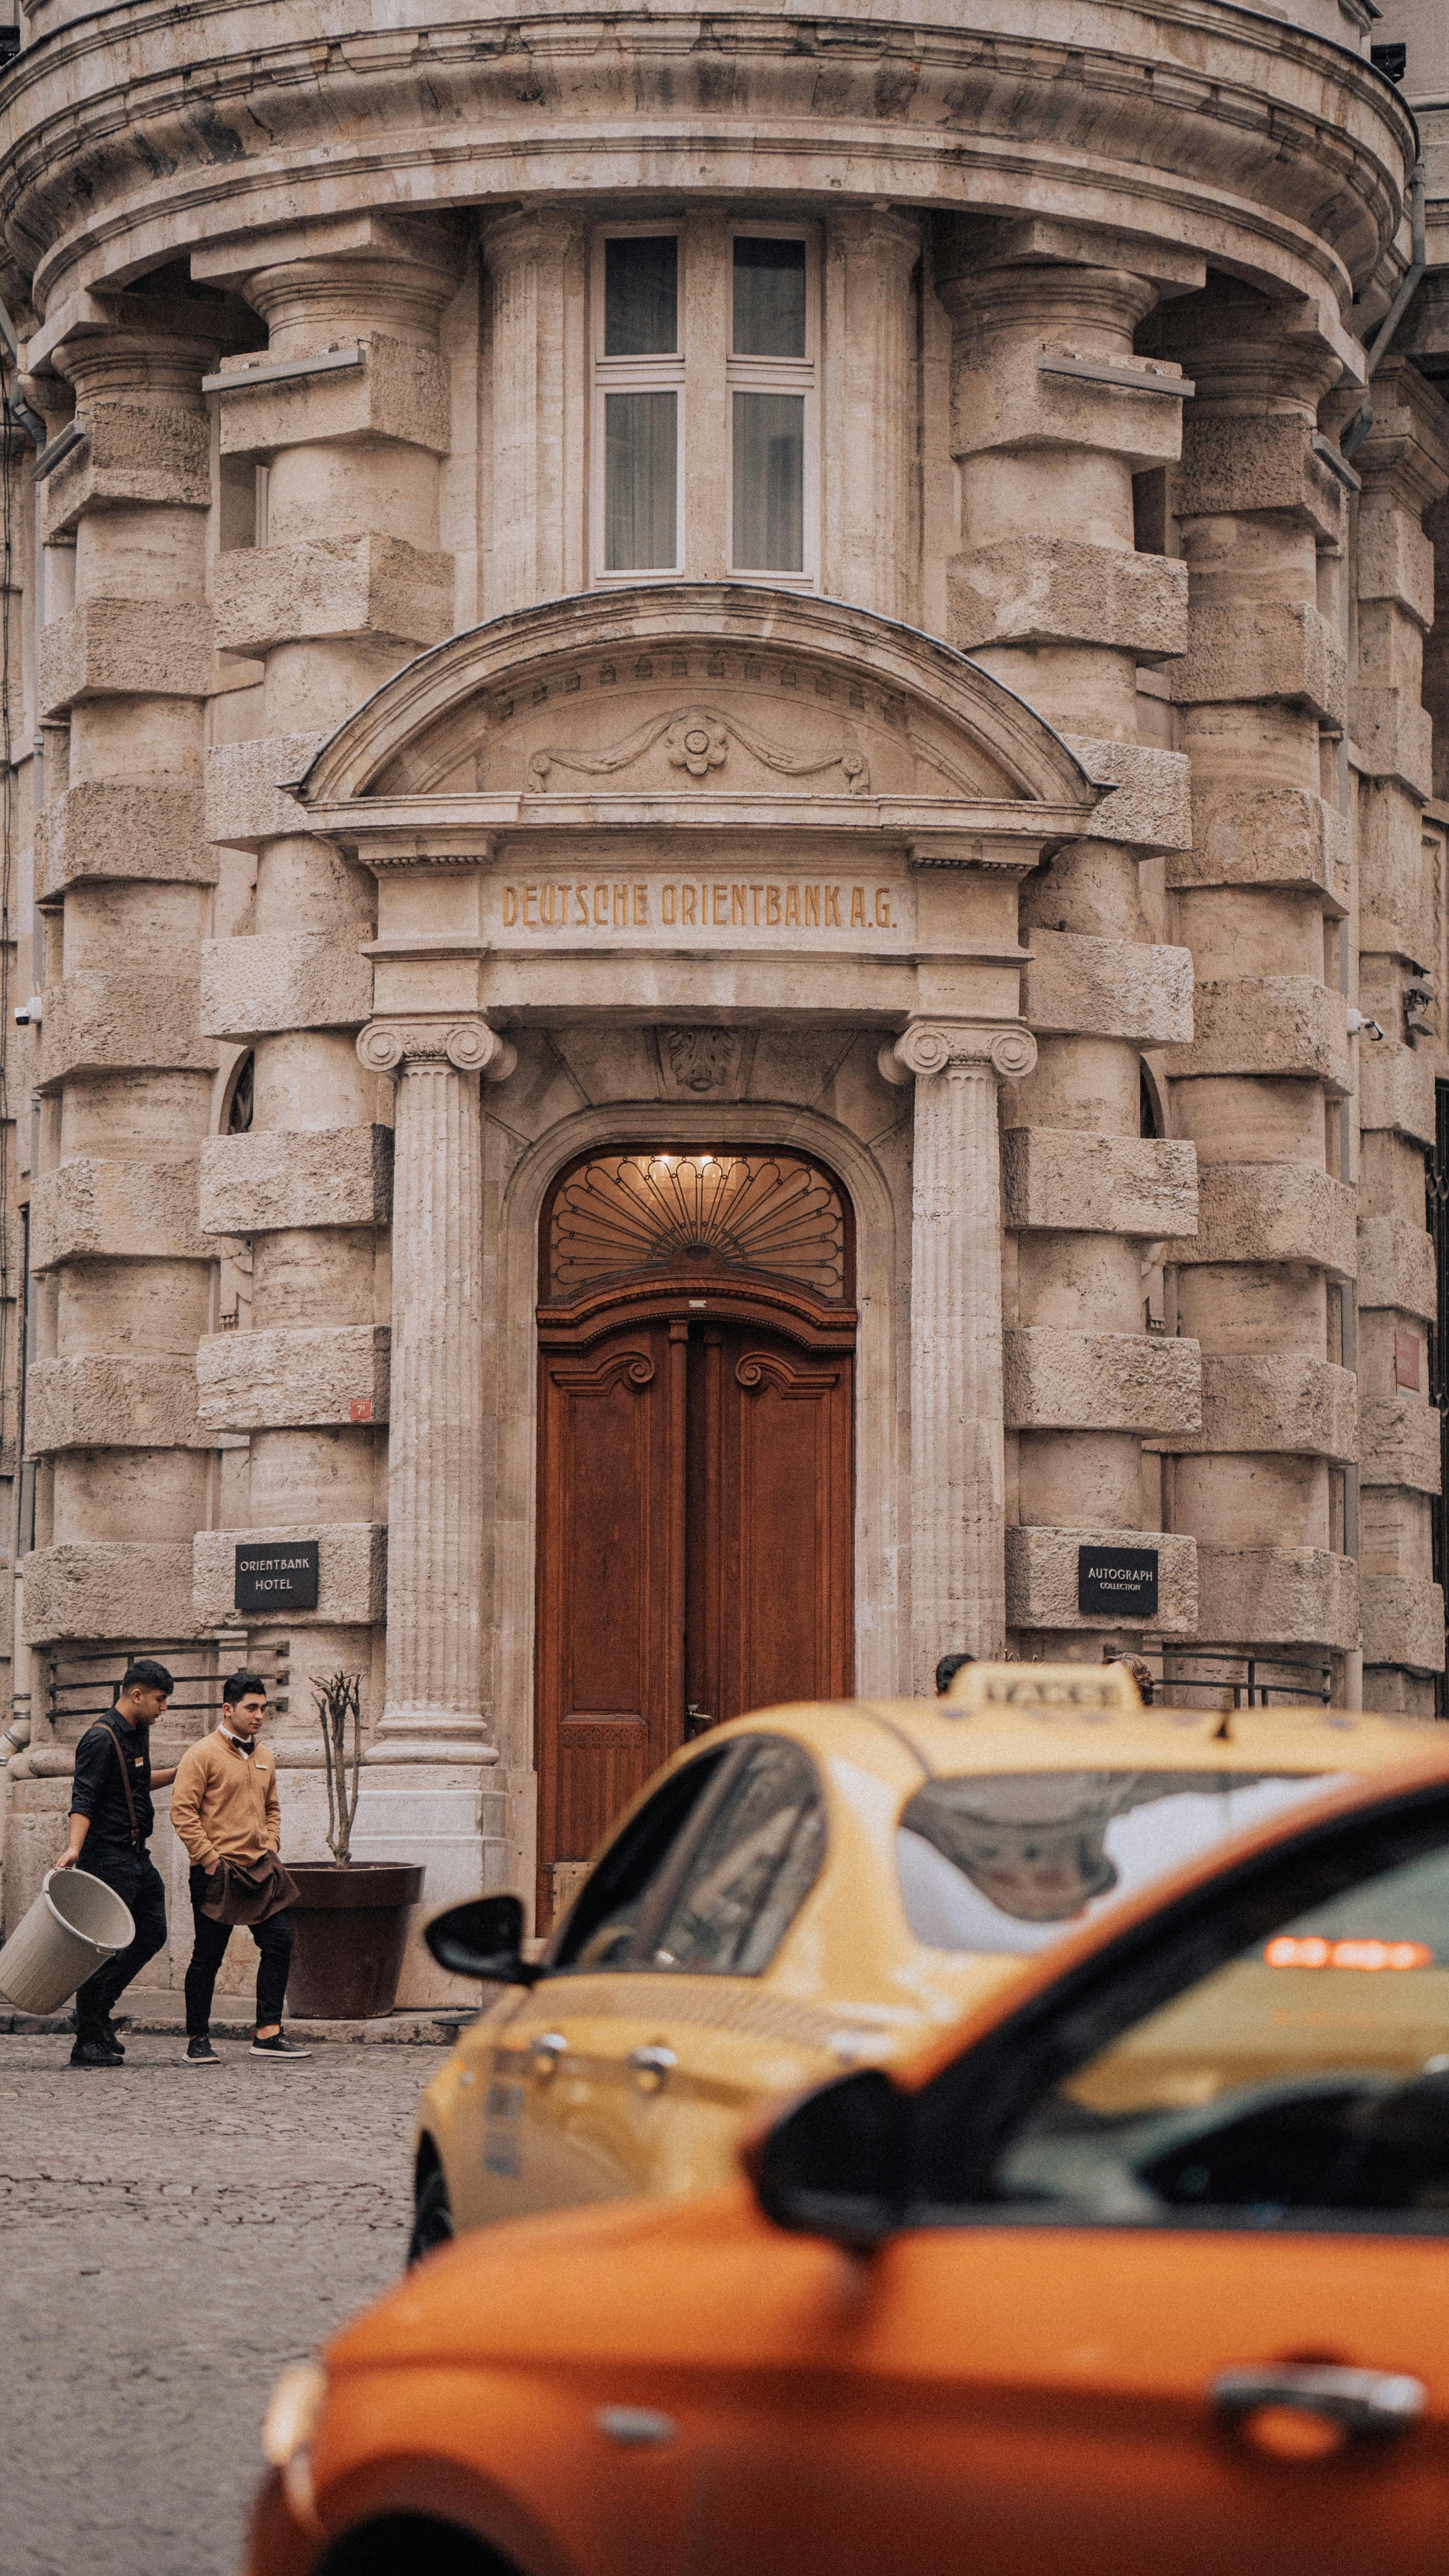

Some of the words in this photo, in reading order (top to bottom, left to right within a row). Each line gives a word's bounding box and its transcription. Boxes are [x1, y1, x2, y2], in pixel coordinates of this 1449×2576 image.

[503, 884, 647, 926] DEUTSCHE
[662, 884, 841, 926] ORIENTBANK
[850, 886, 897, 928] A.G.
[357, 1404, 366, 1415] 7A
[240, 1558, 310, 1572] ORIENTBANK
[1088, 1567, 1153, 1581] AUTOGRAPH
[255, 1579, 293, 1590] HOTEL
[1100, 1582, 1141, 1591] COLLECTION
